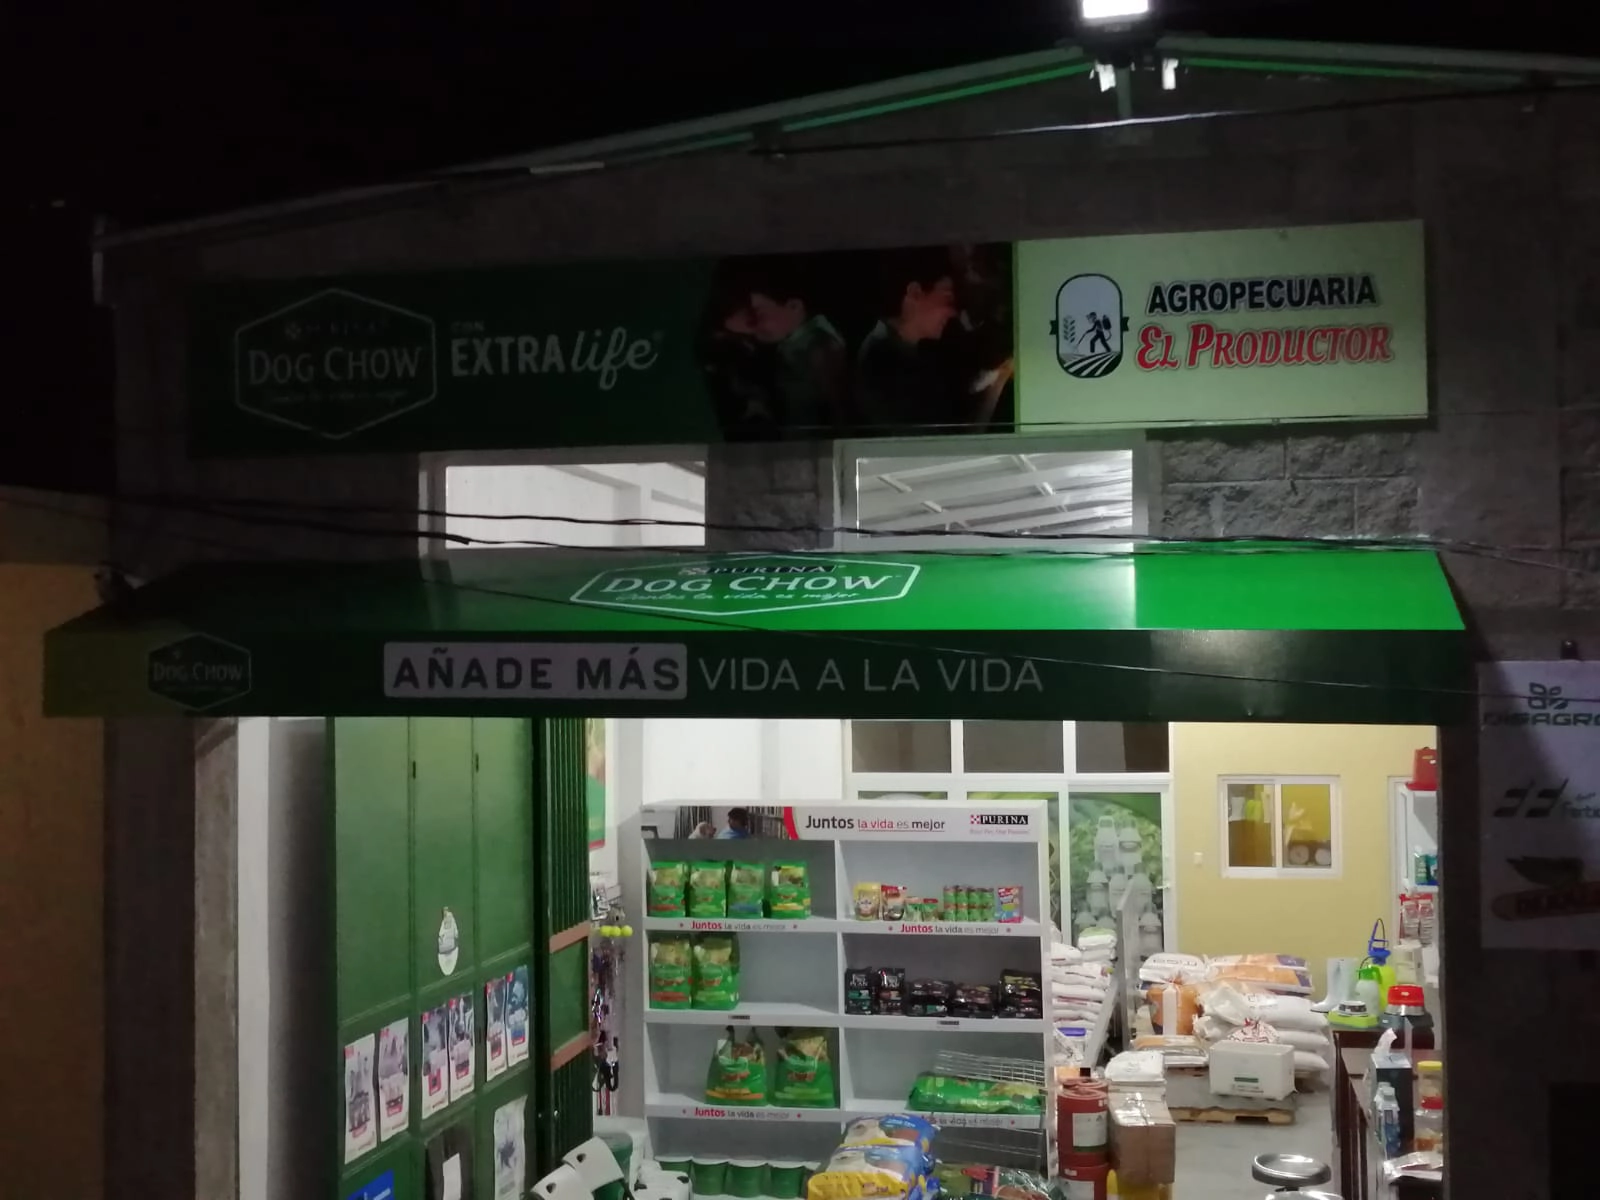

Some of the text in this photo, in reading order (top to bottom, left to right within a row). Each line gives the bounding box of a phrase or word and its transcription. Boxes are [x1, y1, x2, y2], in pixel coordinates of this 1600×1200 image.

[1149, 276, 1377, 314] AGROPECUARIA
[1187, 322, 1392, 368] PRODUCTOR
[248, 346, 422, 385] DOG CHOW
[714, 566, 827, 574] PURINA
[600, 576, 893, 592] DOG CHOW
[393, 647, 1044, 692] AÑADE MÁS VIDA A LA VIDA
[805, 815, 945, 832] Juntos la vida es mejor
[982, 815, 1027, 824] PURINA
[691, 920, 722, 930] Juntos
[901, 924, 933, 933] Juntos
[945, 925, 963, 934] vida
[695, 1107, 726, 1118] Juntos
